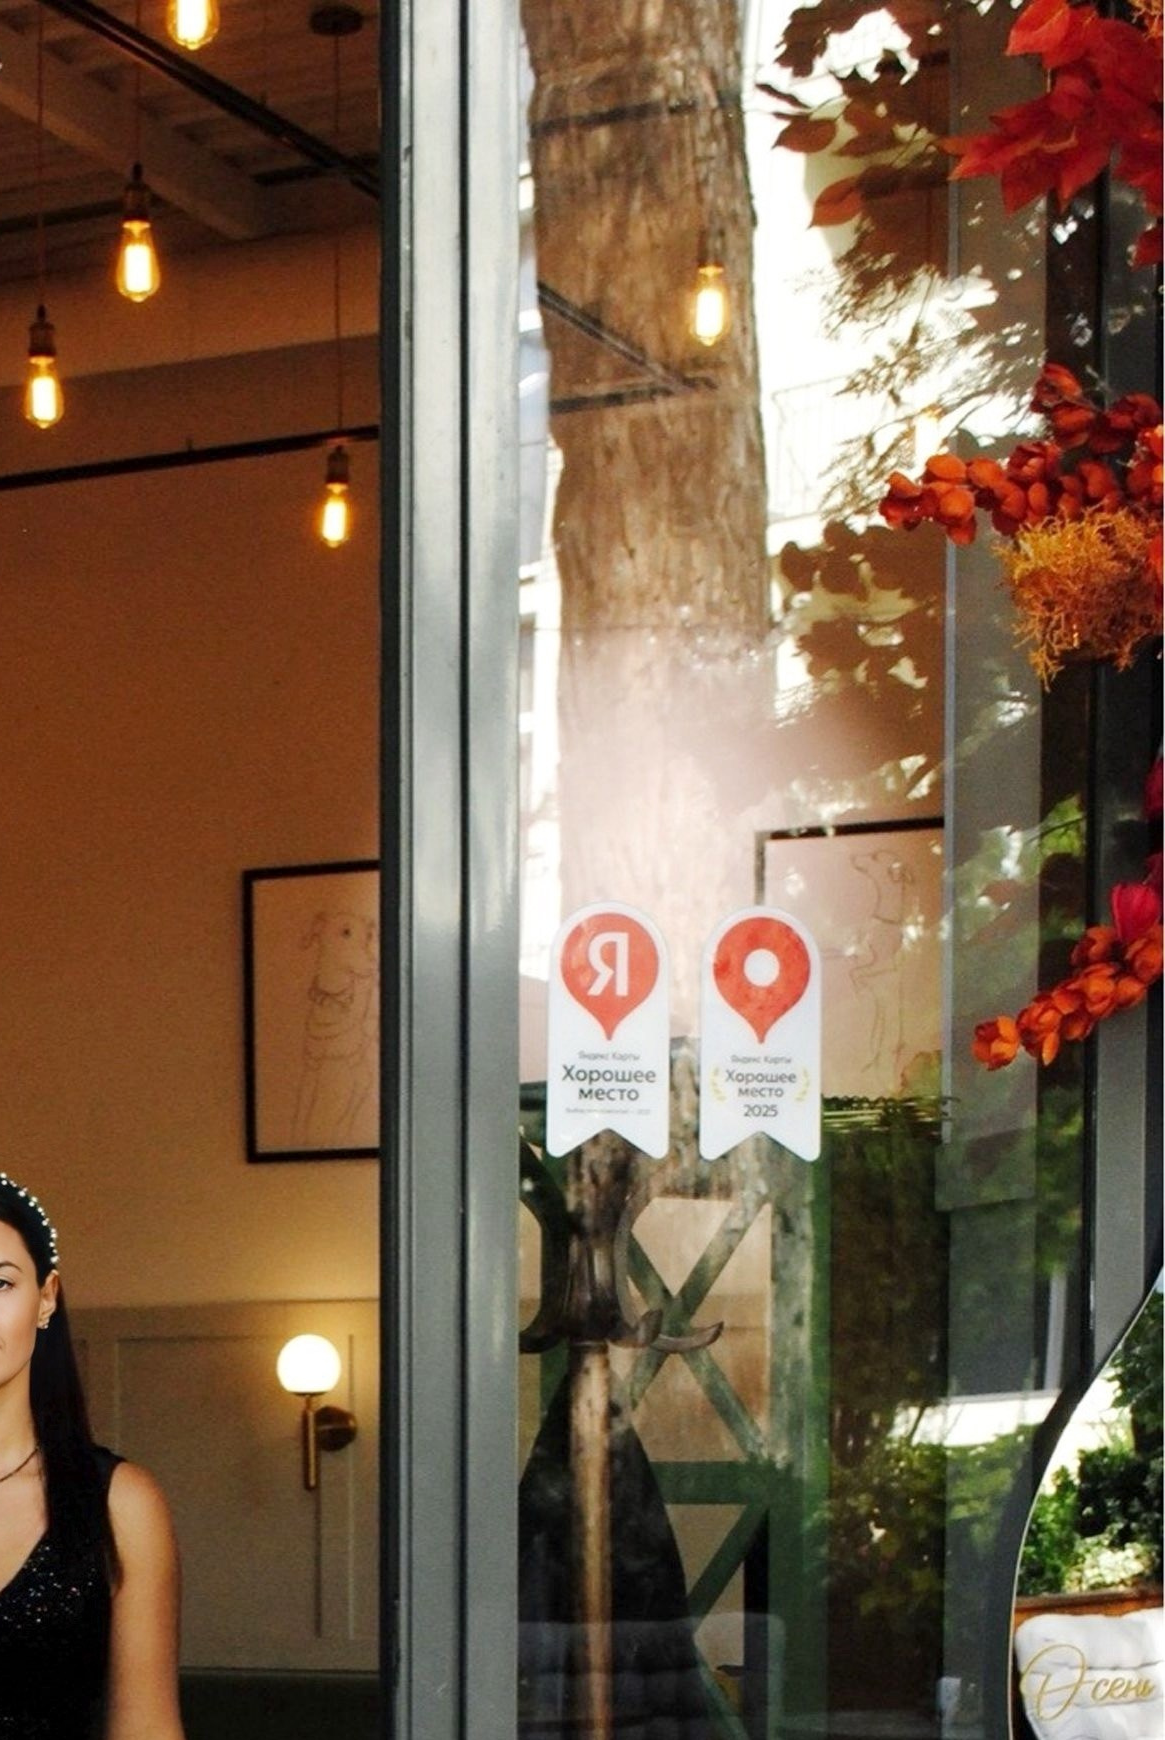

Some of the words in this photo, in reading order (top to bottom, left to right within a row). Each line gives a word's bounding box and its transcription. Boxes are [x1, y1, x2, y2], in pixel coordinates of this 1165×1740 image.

[587, 931, 630, 997] Я
[562, 1065, 656, 1085] Хорошее
[725, 1069, 797, 1084] Хорошее
[578, 1088, 639, 1101] место
[738, 1087, 784, 1098] место
[744, 1105, 778, 1117] 2025
